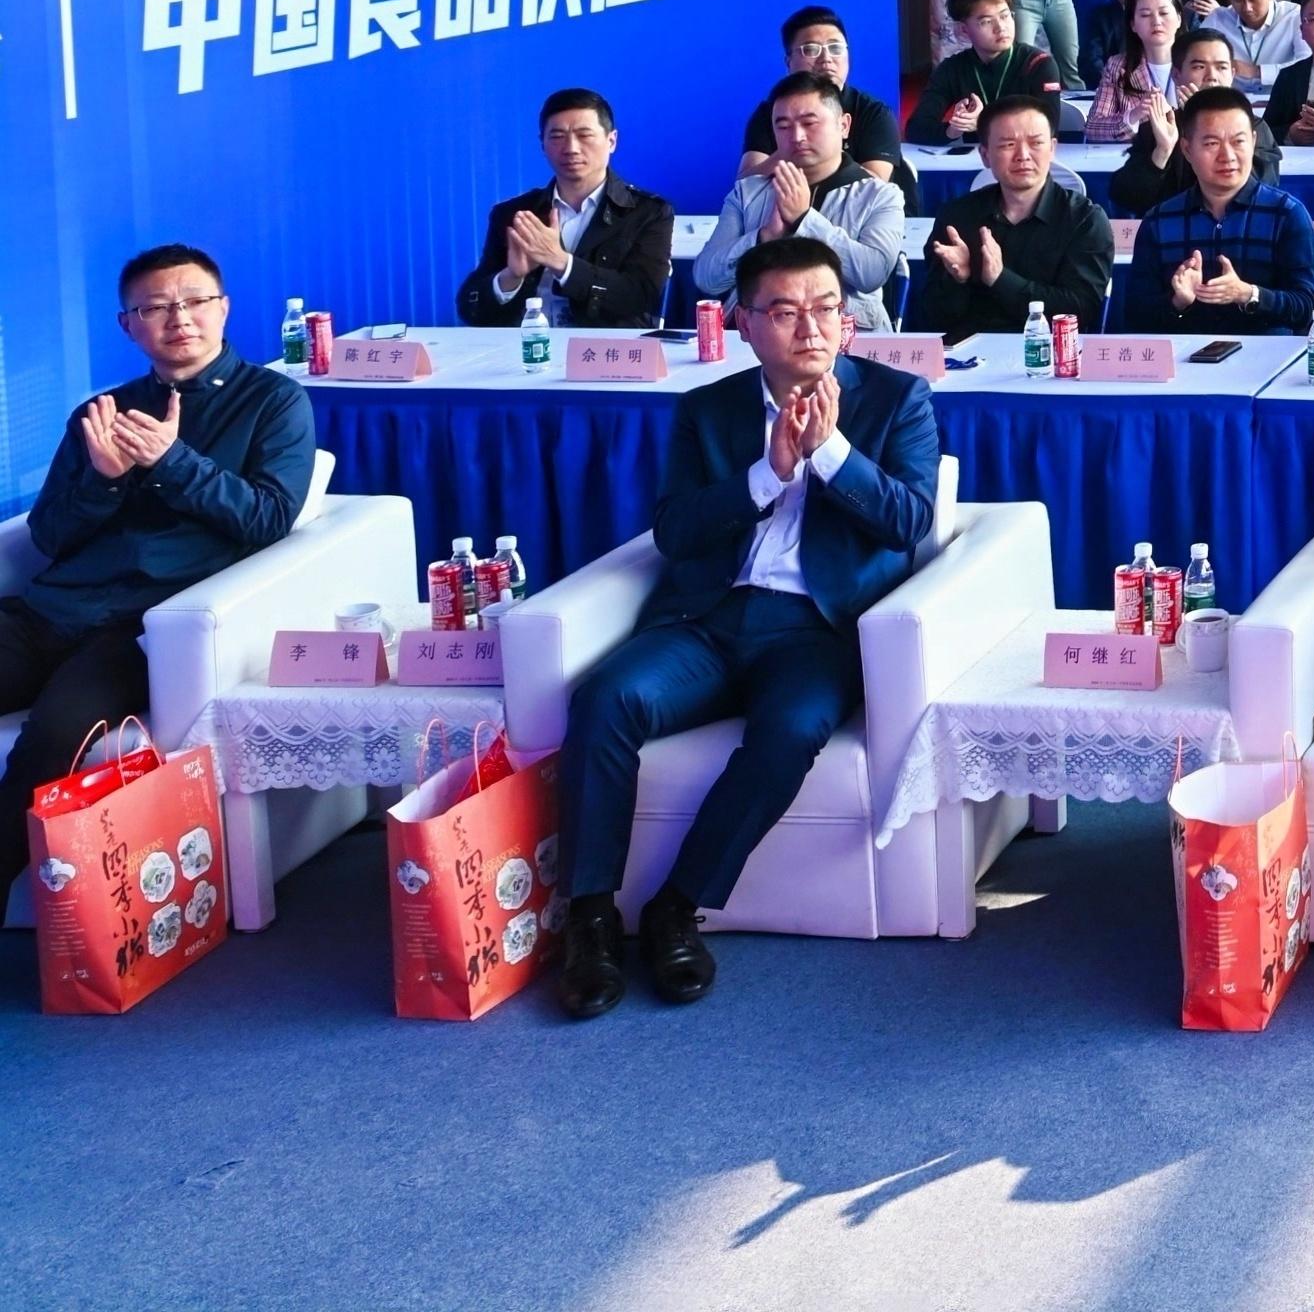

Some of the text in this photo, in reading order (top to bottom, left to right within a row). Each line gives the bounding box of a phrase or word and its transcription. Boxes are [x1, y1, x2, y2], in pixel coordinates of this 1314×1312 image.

[344, 347, 404, 364] 陈红宇
[1096, 347, 1155, 362] 王浩业
[417, 640, 496, 661] 刘志刚
[1063, 645, 1137, 665] 何继红
